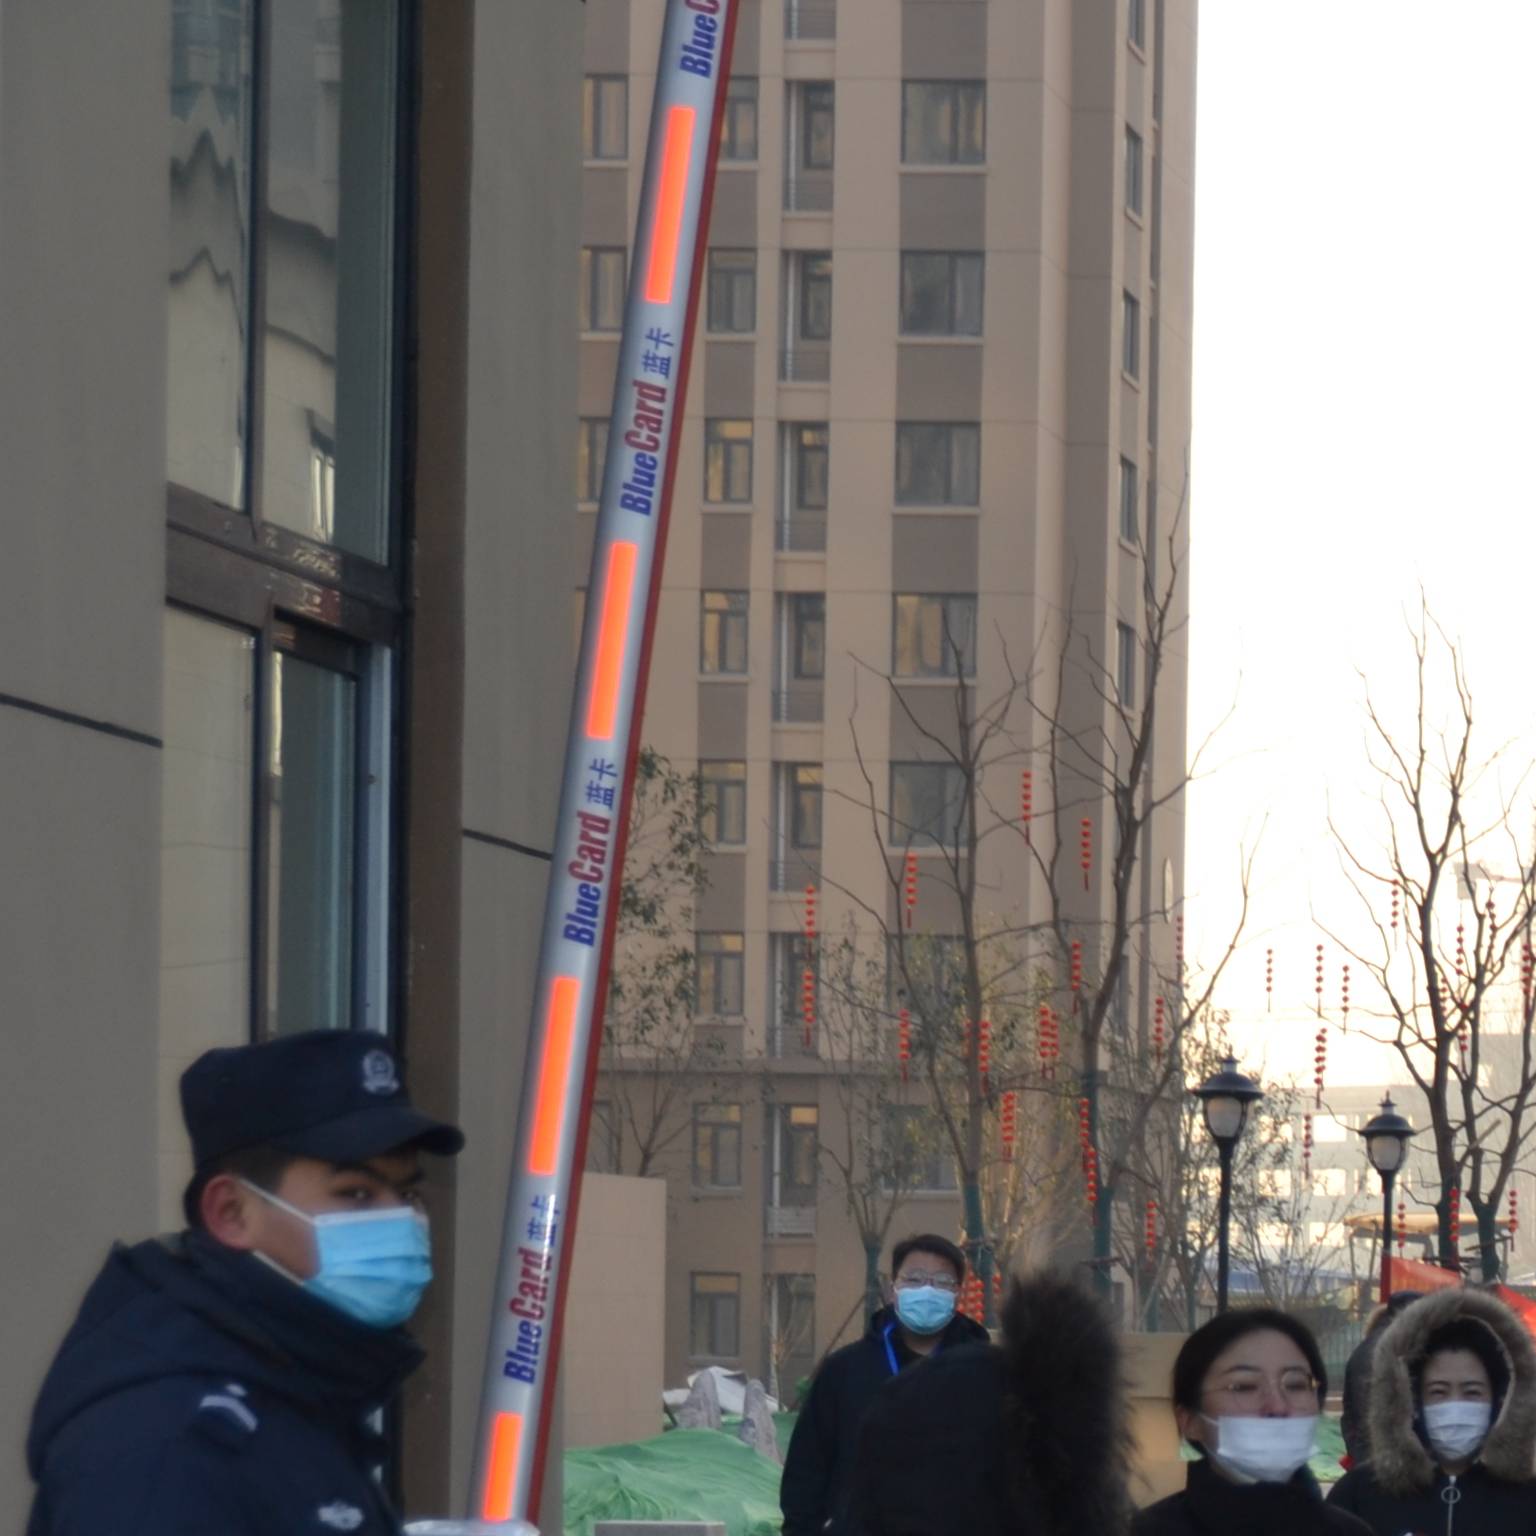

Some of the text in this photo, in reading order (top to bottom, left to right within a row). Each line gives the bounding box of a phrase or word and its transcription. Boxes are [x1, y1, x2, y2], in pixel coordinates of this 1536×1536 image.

[619, 327, 674, 516] BlueCard 蓝卡
[563, 757, 618, 947] BlueCard 蓝卡
[503, 1247, 553, 1385] BlueCard
